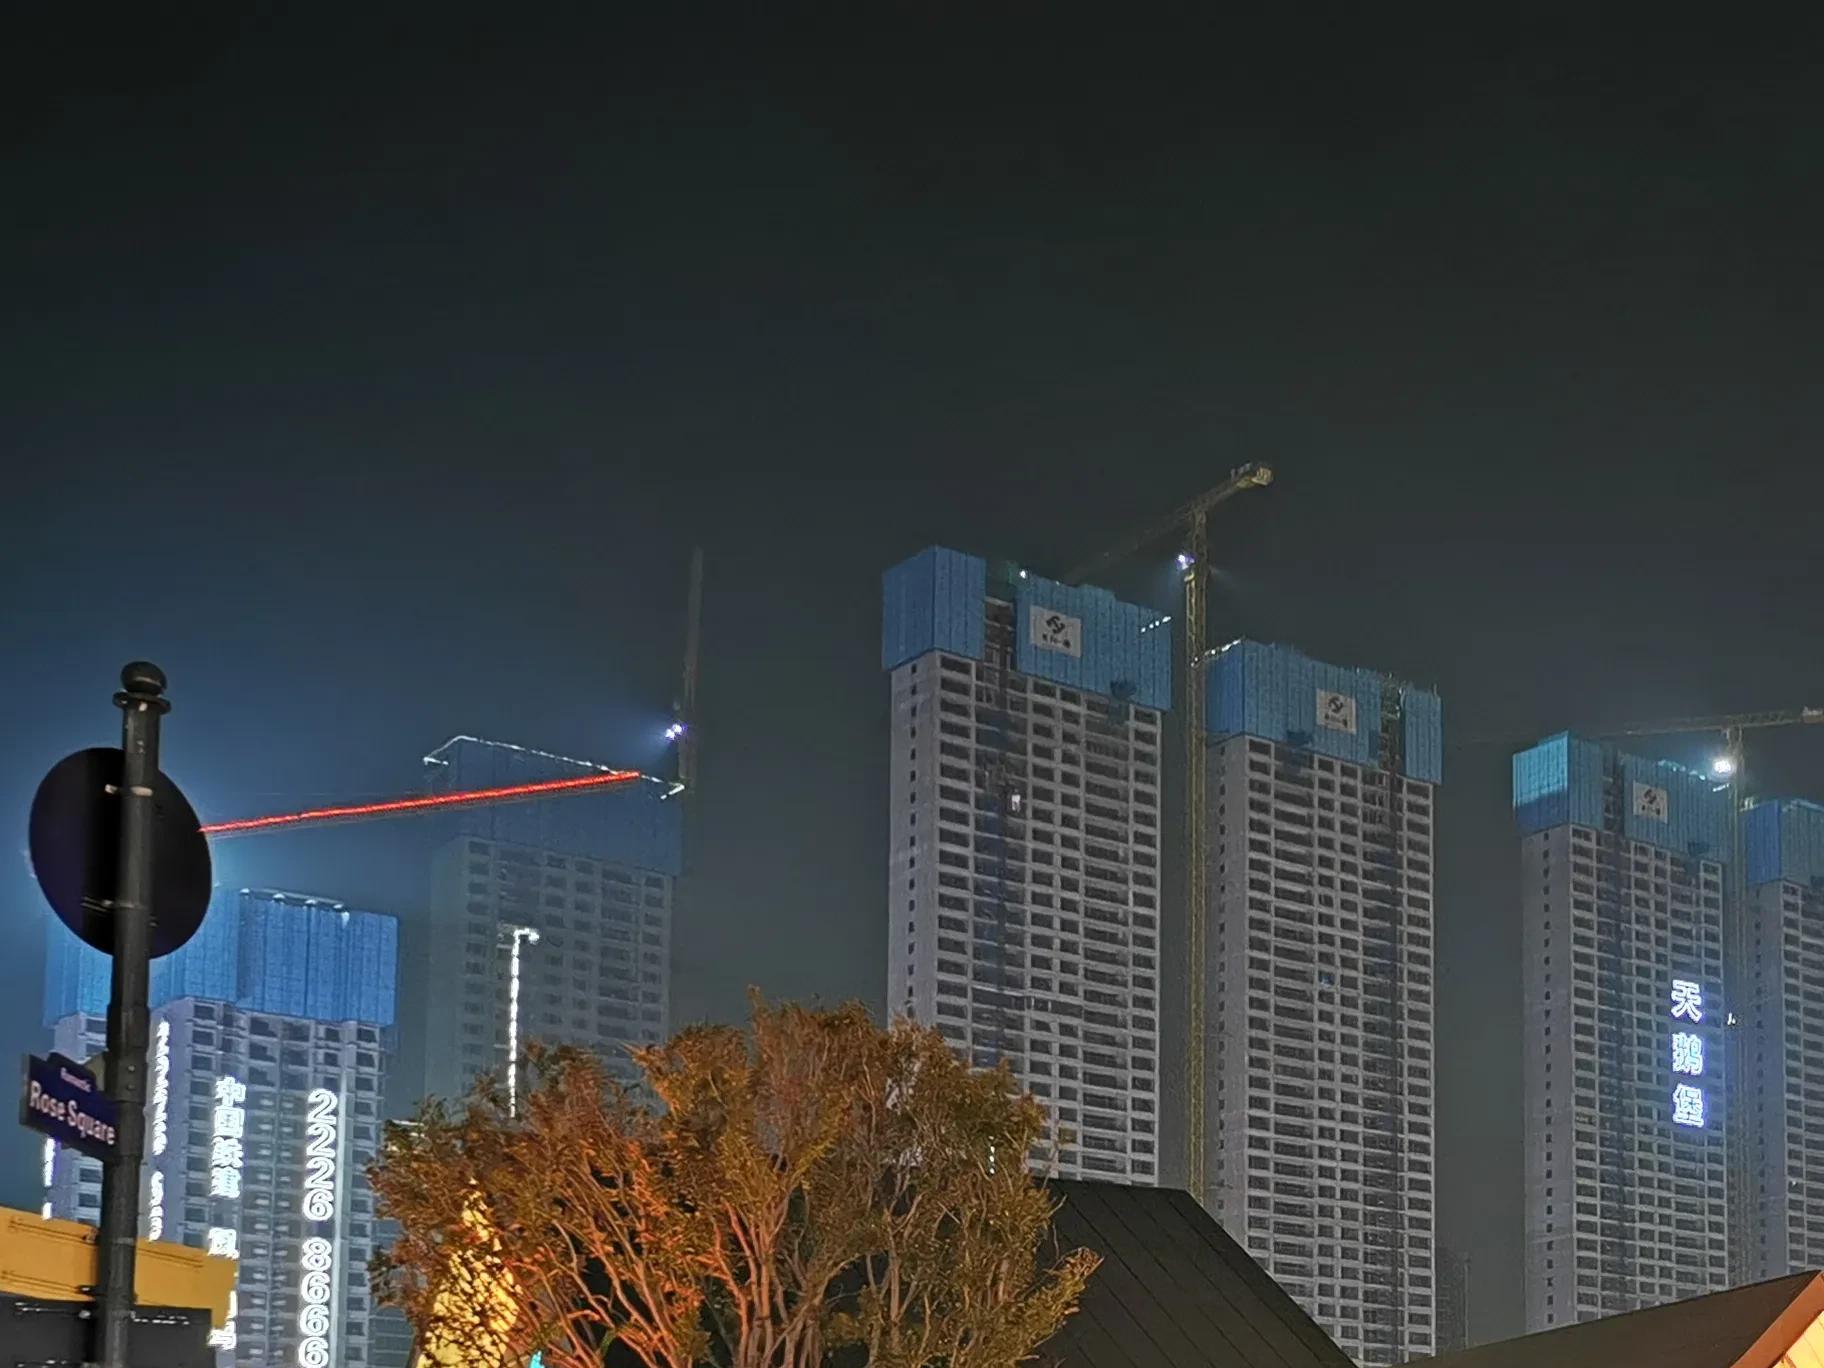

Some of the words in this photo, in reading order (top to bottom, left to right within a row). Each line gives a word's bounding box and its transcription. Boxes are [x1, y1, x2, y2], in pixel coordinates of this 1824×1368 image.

[30, 1080, 66, 1121] Rose
[67, 1099, 115, 1145] Square
[1671, 979, 1704, 1128] 天鹅堡
[303, 1088, 338, 1221] 2226
